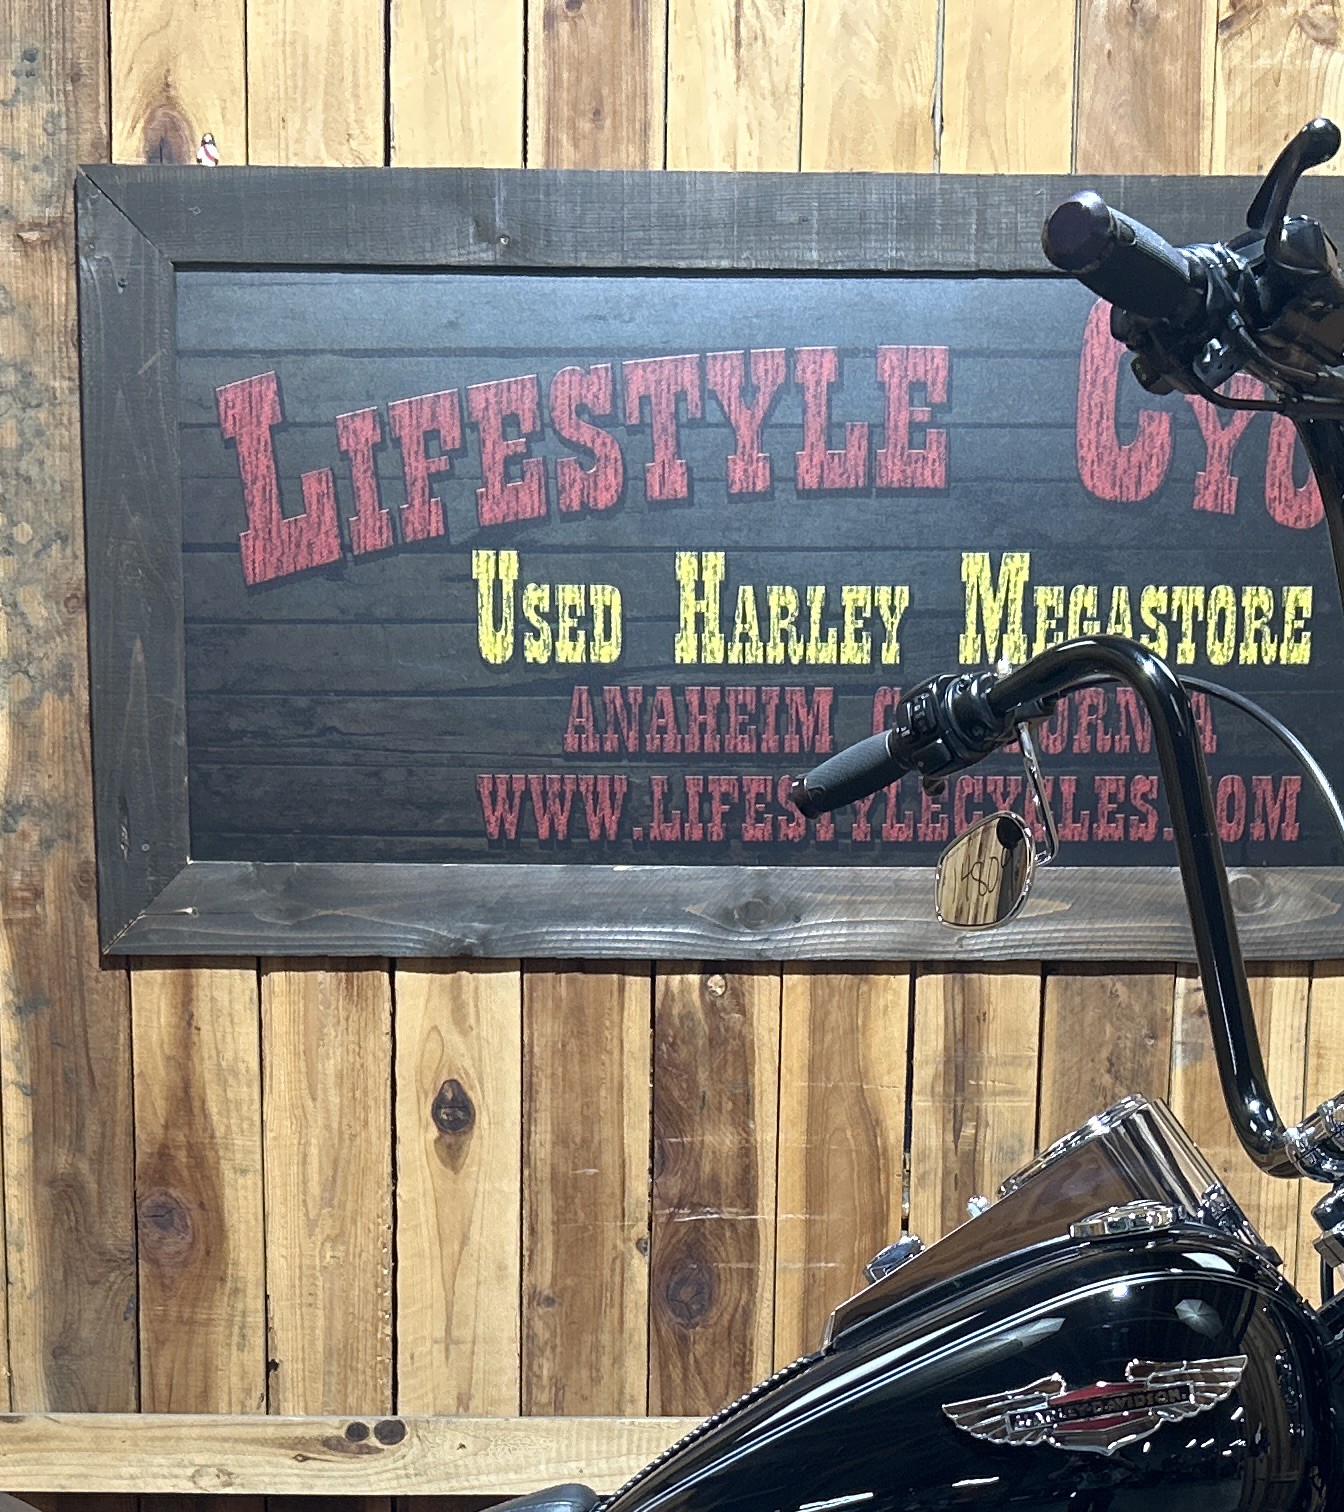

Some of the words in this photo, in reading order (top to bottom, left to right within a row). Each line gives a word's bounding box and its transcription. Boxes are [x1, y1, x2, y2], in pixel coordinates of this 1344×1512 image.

[471, 549, 623, 665] USED
[673, 550, 911, 665] HARLEY
[958, 551, 1314, 666] MEGASTORE
[563, 685, 835, 754] ANAHEIM
[476, 773, 1304, 844] WWW.LIFESYLECYCLES.OM
